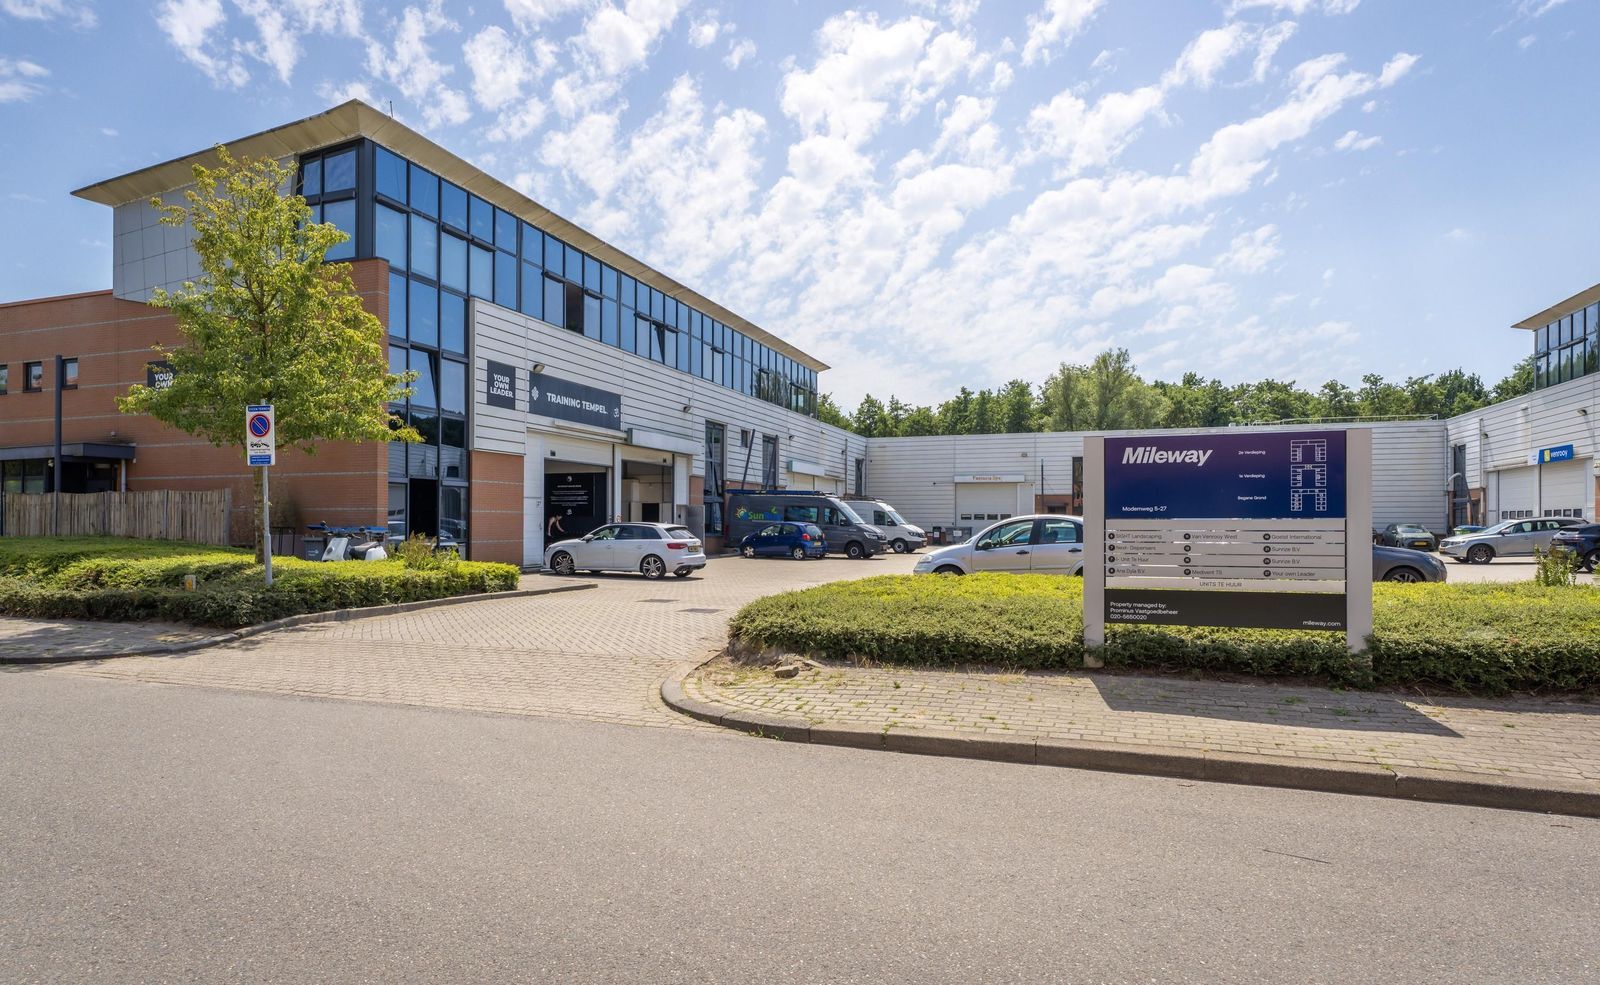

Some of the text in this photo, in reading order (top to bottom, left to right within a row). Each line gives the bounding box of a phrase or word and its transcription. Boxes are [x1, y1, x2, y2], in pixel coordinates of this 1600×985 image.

[155, 372, 174, 381] YOUR
[493, 373, 510, 384] YOUR
[494, 381, 509, 390] OWN
[546, 392, 581, 409] TRAINING
[1122, 446, 1213, 467] Mileway
[1302, 620, 1341, 628] mileway.com
